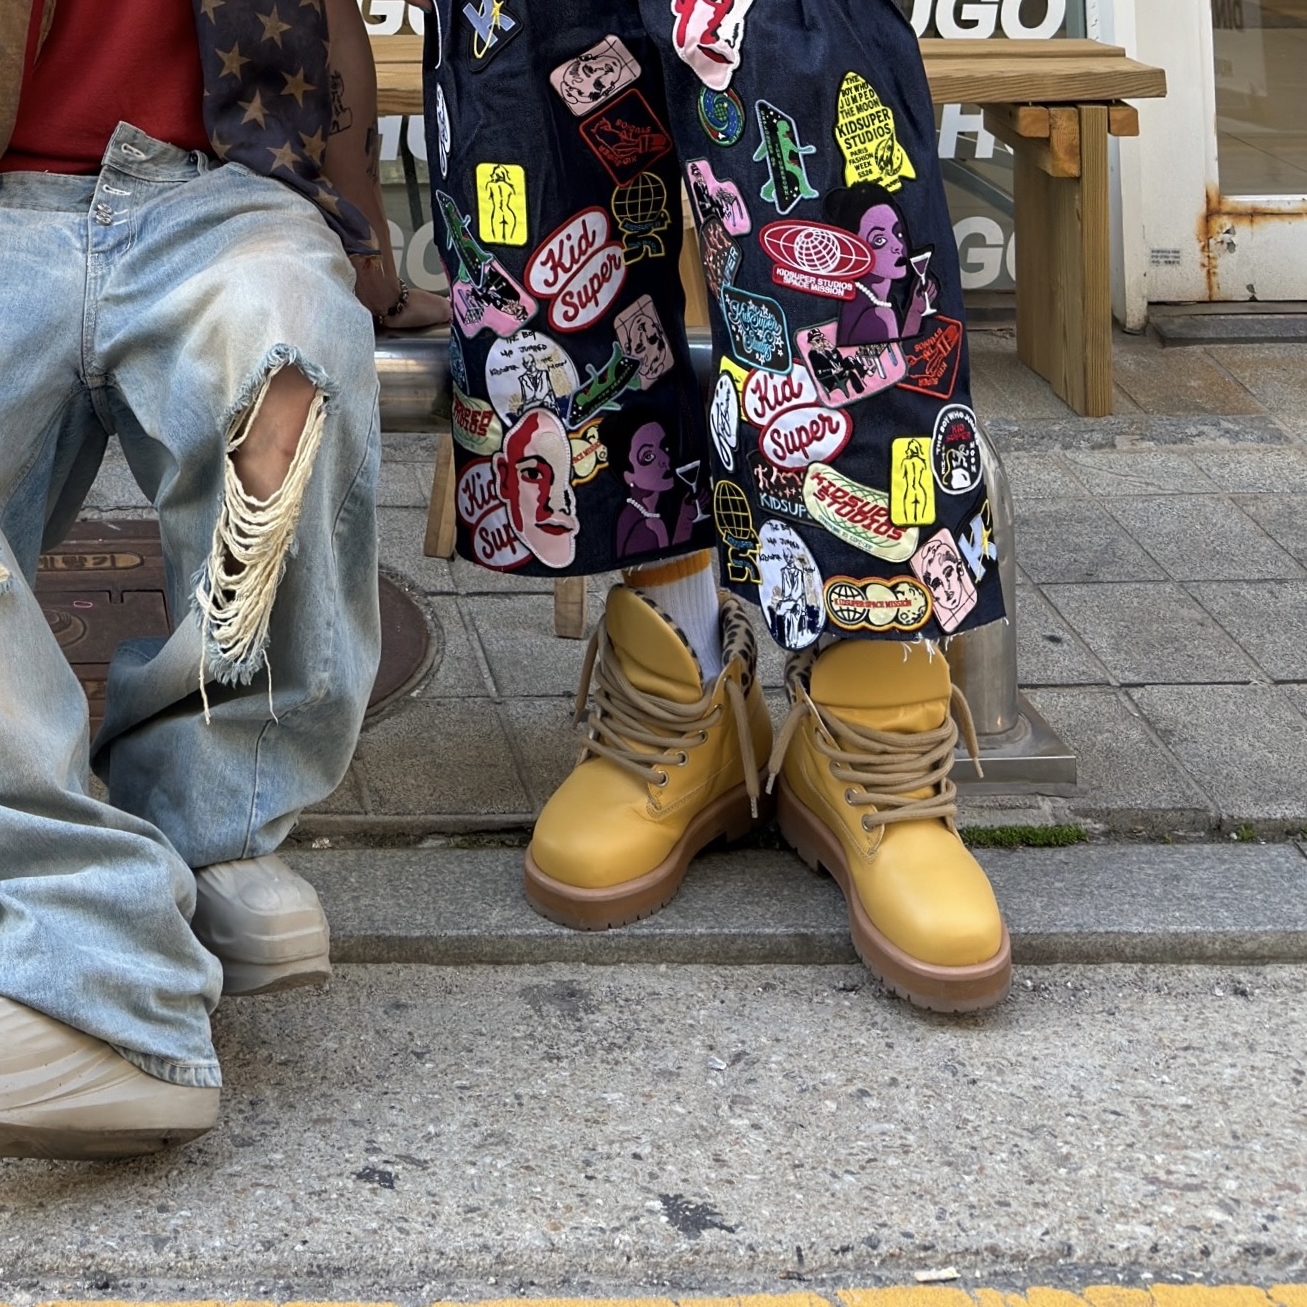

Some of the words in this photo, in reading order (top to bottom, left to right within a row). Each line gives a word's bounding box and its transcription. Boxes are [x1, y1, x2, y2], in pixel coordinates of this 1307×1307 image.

[845, 75, 860, 86] THE
[839, 88, 875, 109] JUMPED
[839, 105, 856, 120] THE
[855, 98, 880, 116] MOON
[836, 108, 891, 138] KIDSUPER
[844, 123, 891, 150] STUDIOS
[848, 152, 873, 165] FASHION
[850, 147, 869, 157] PARIS
[854, 161, 872, 171] WEEK
[540, 219, 597, 288] Kid
[561, 252, 622, 322] Super
[776, 267, 816, 284] KIDSUPER
[817, 278, 853, 291] STUDIOS
[783, 275, 810, 289] SPACE
[810, 283, 844, 296] MISSION
[750, 373, 803, 419] Kid
[769, 413, 841, 462] Super
[759, 492, 811, 519] KIDSUP
[810, 472, 890, 519] KIDSUP
[813, 489, 904, 541] STUDIOS
[479, 526, 518, 560] Sup
